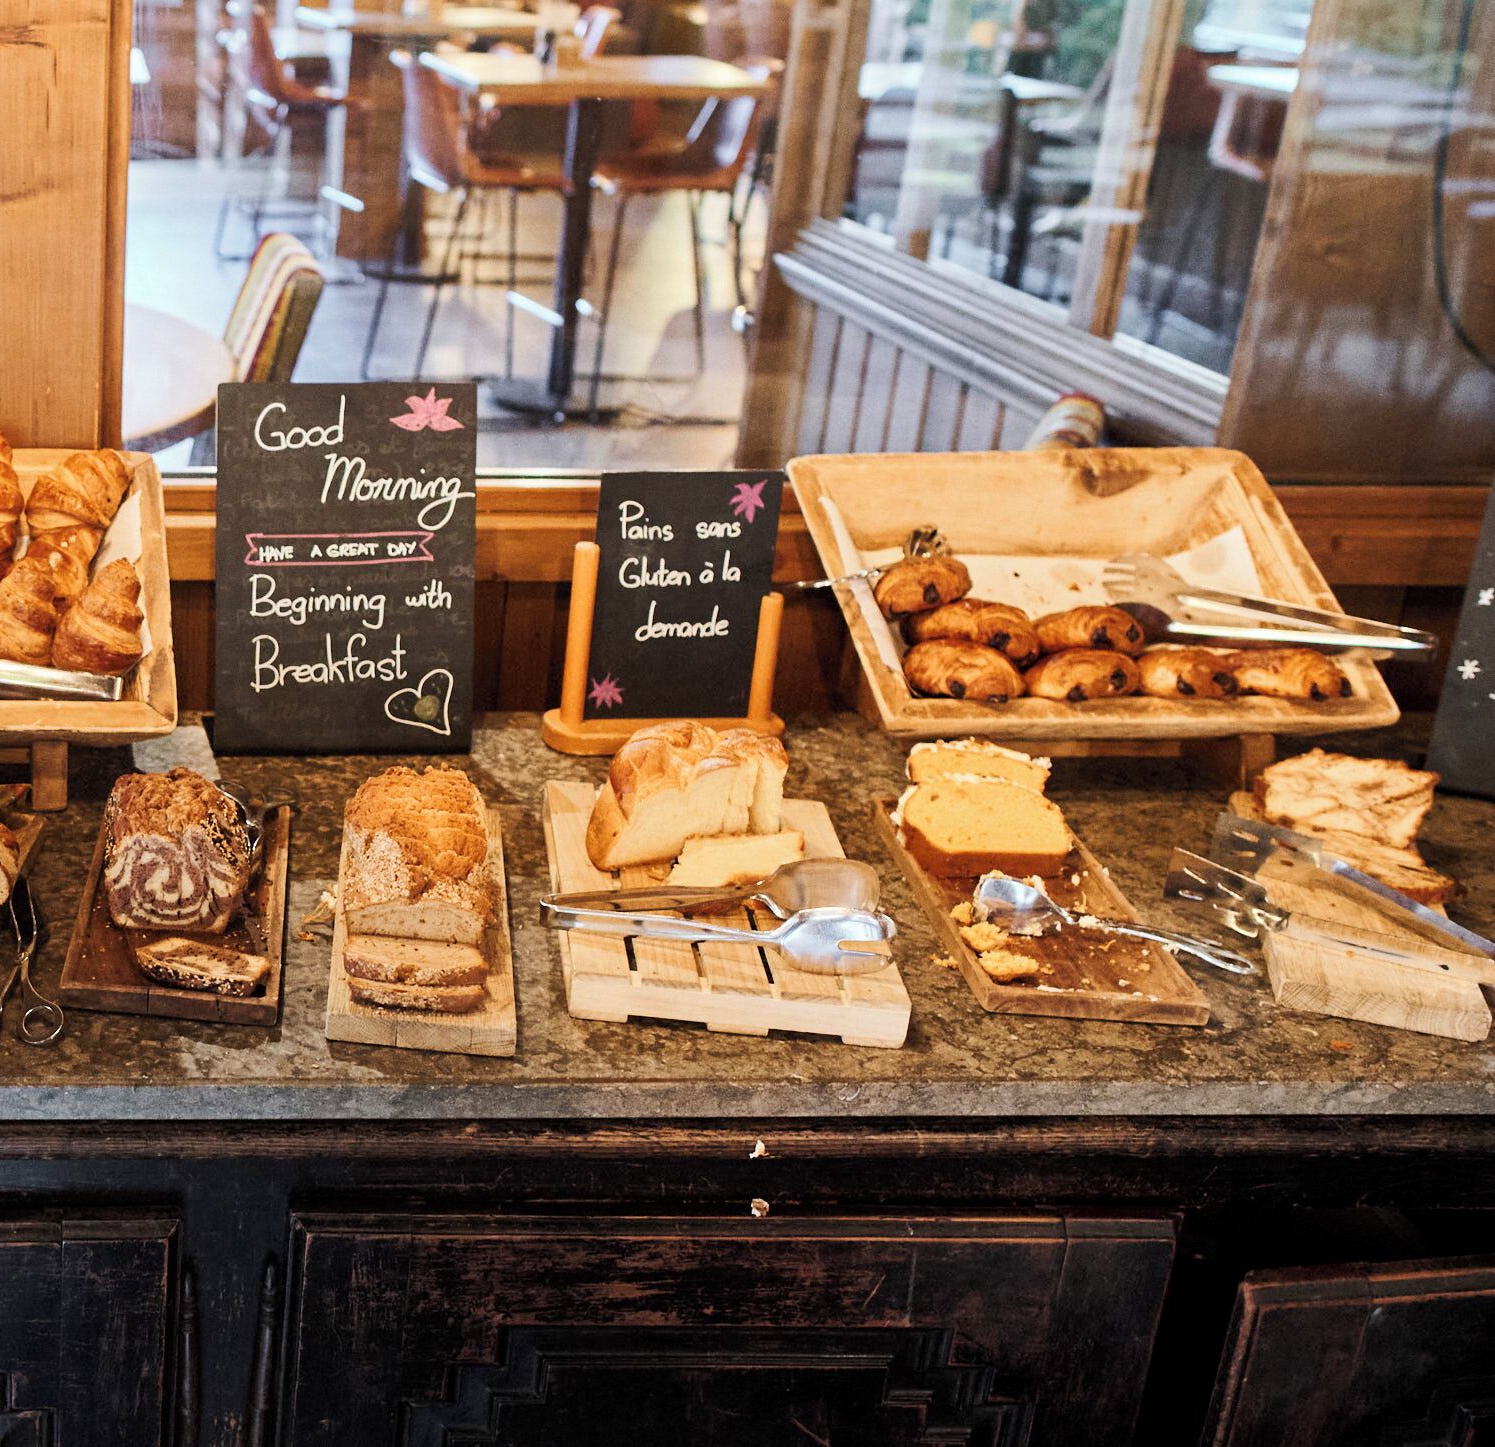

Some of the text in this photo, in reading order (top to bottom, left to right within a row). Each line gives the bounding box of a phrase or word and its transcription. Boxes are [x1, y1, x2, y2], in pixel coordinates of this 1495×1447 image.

[255, 394, 346, 451] Good
[320, 453, 476, 531] Morning
[618, 500, 742, 542] Pains sans
[258, 541, 417, 563] HAVE A GREAT DAY
[618, 549, 741, 589] Gluten à la
[250, 574, 453, 630] Beginning with
[635, 600, 730, 641] demande
[250, 632, 408, 693] Breakfast
